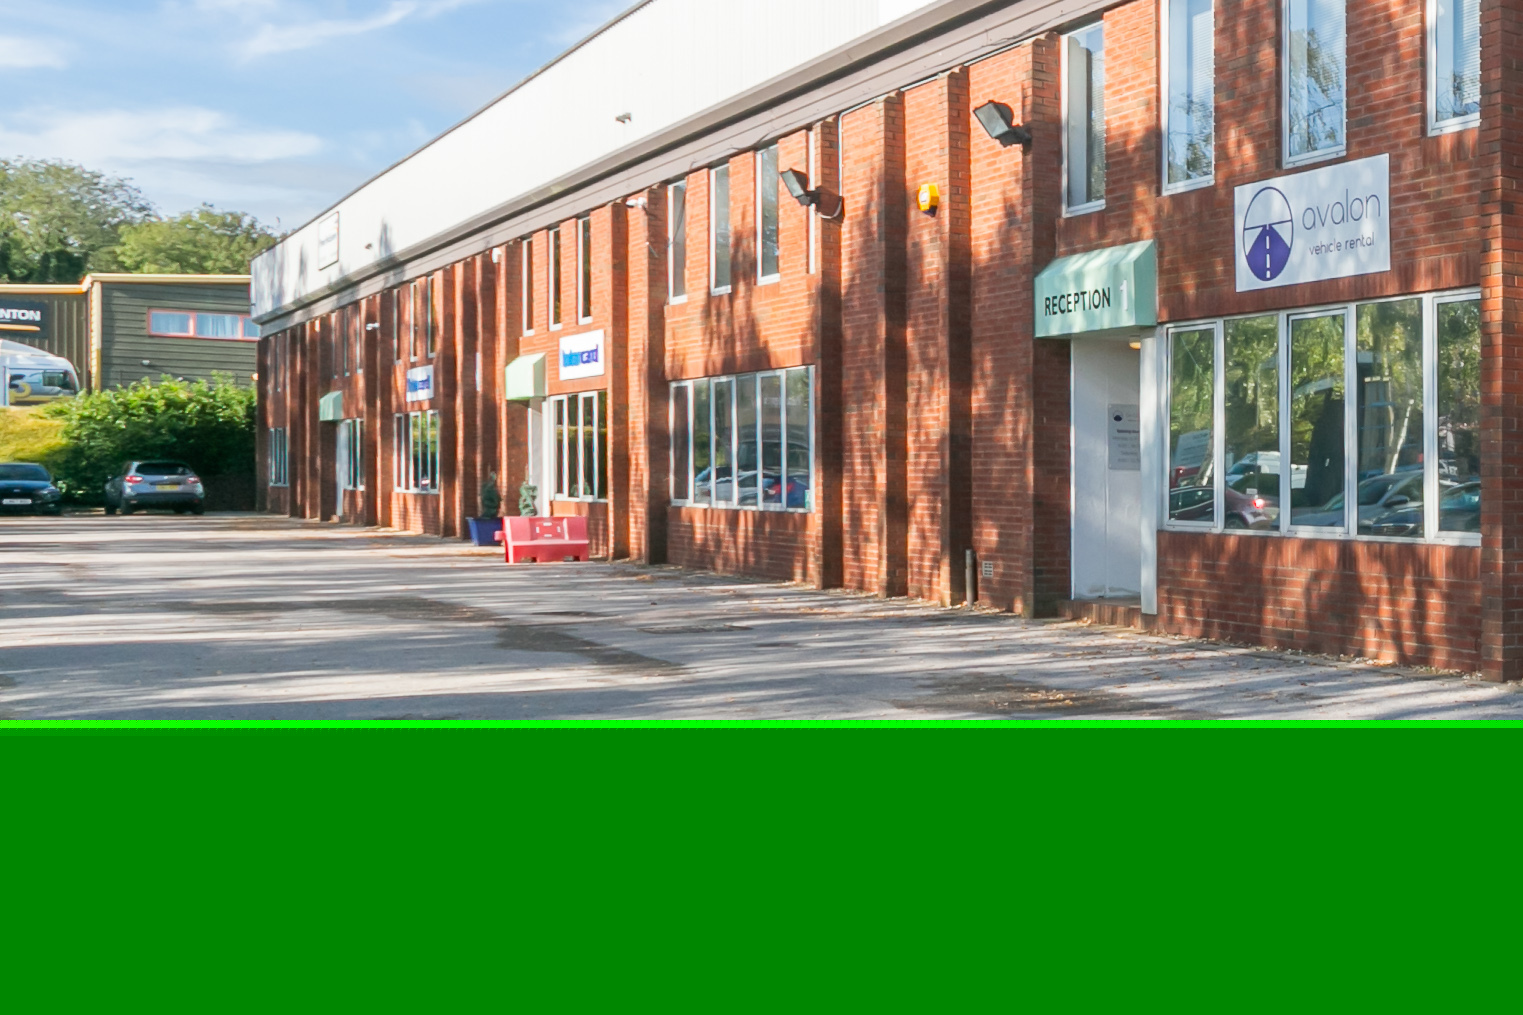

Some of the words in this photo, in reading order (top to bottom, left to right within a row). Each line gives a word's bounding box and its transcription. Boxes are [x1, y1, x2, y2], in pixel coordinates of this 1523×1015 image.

[1302, 188, 1381, 231] avalon
[1309, 237, 1342, 255] vehicle
[1344, 231, 1375, 250] rental
[1044, 286, 1111, 316] RECEPTION
[1119, 279, 1129, 312] 1
